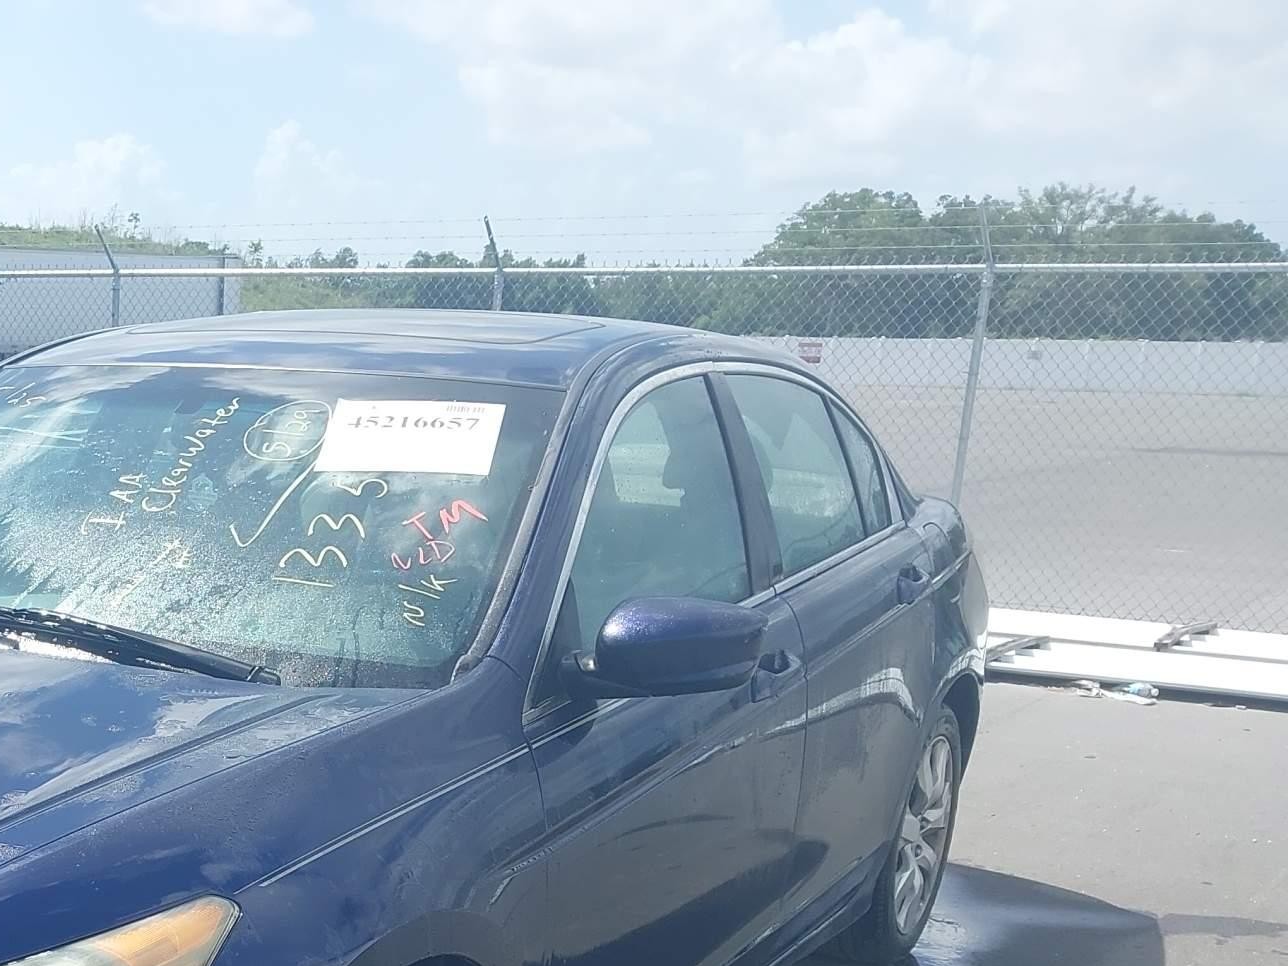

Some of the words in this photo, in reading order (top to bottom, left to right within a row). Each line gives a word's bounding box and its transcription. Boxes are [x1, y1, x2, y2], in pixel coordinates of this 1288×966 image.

[347, 415, 480, 430] 45216657
[272, 477, 389, 588] 1335
[401, 499, 489, 540] TM
